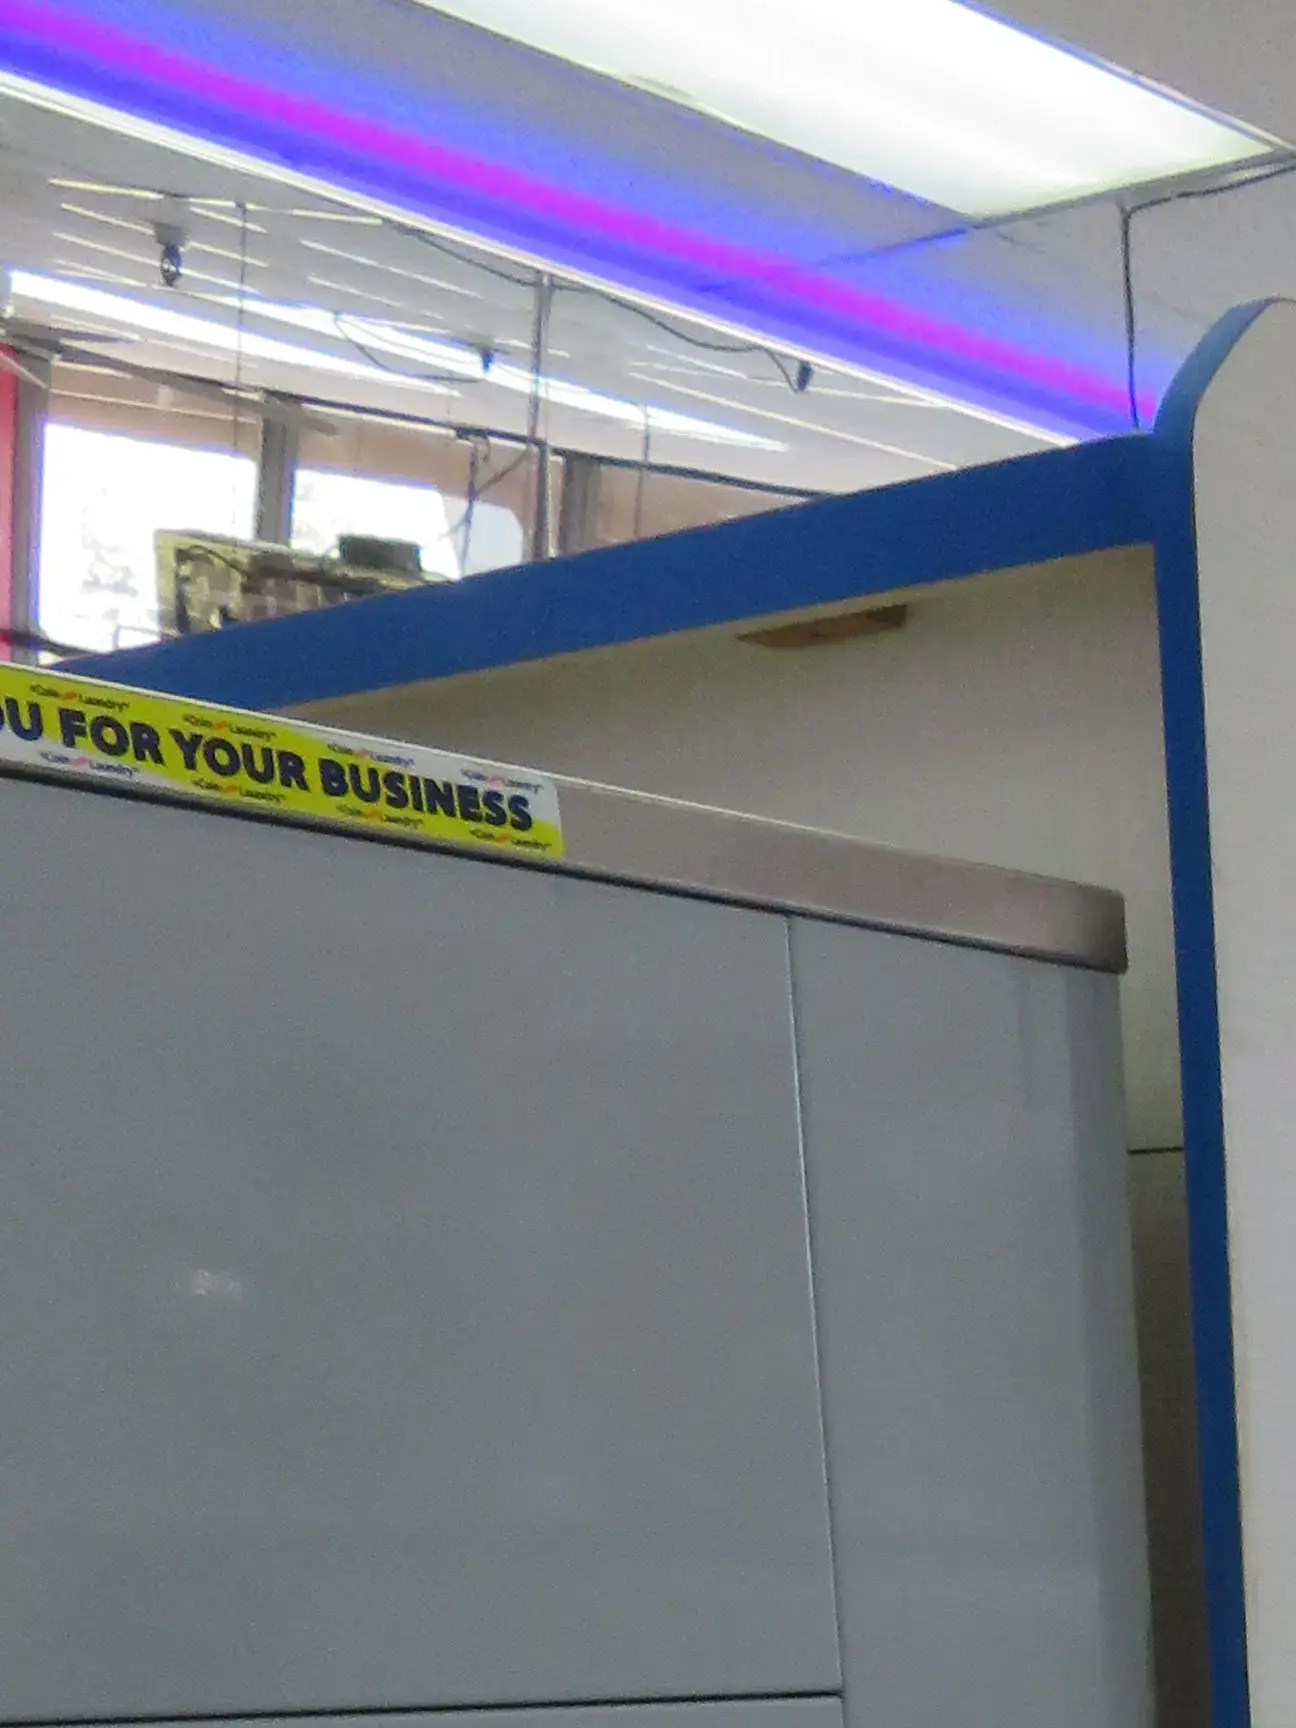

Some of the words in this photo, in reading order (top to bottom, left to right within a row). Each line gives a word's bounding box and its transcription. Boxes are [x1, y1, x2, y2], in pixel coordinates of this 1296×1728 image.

[58, 707, 165, 767] FOR
[169, 727, 312, 792] YOUR
[317, 758, 533, 832] BUSINESS
